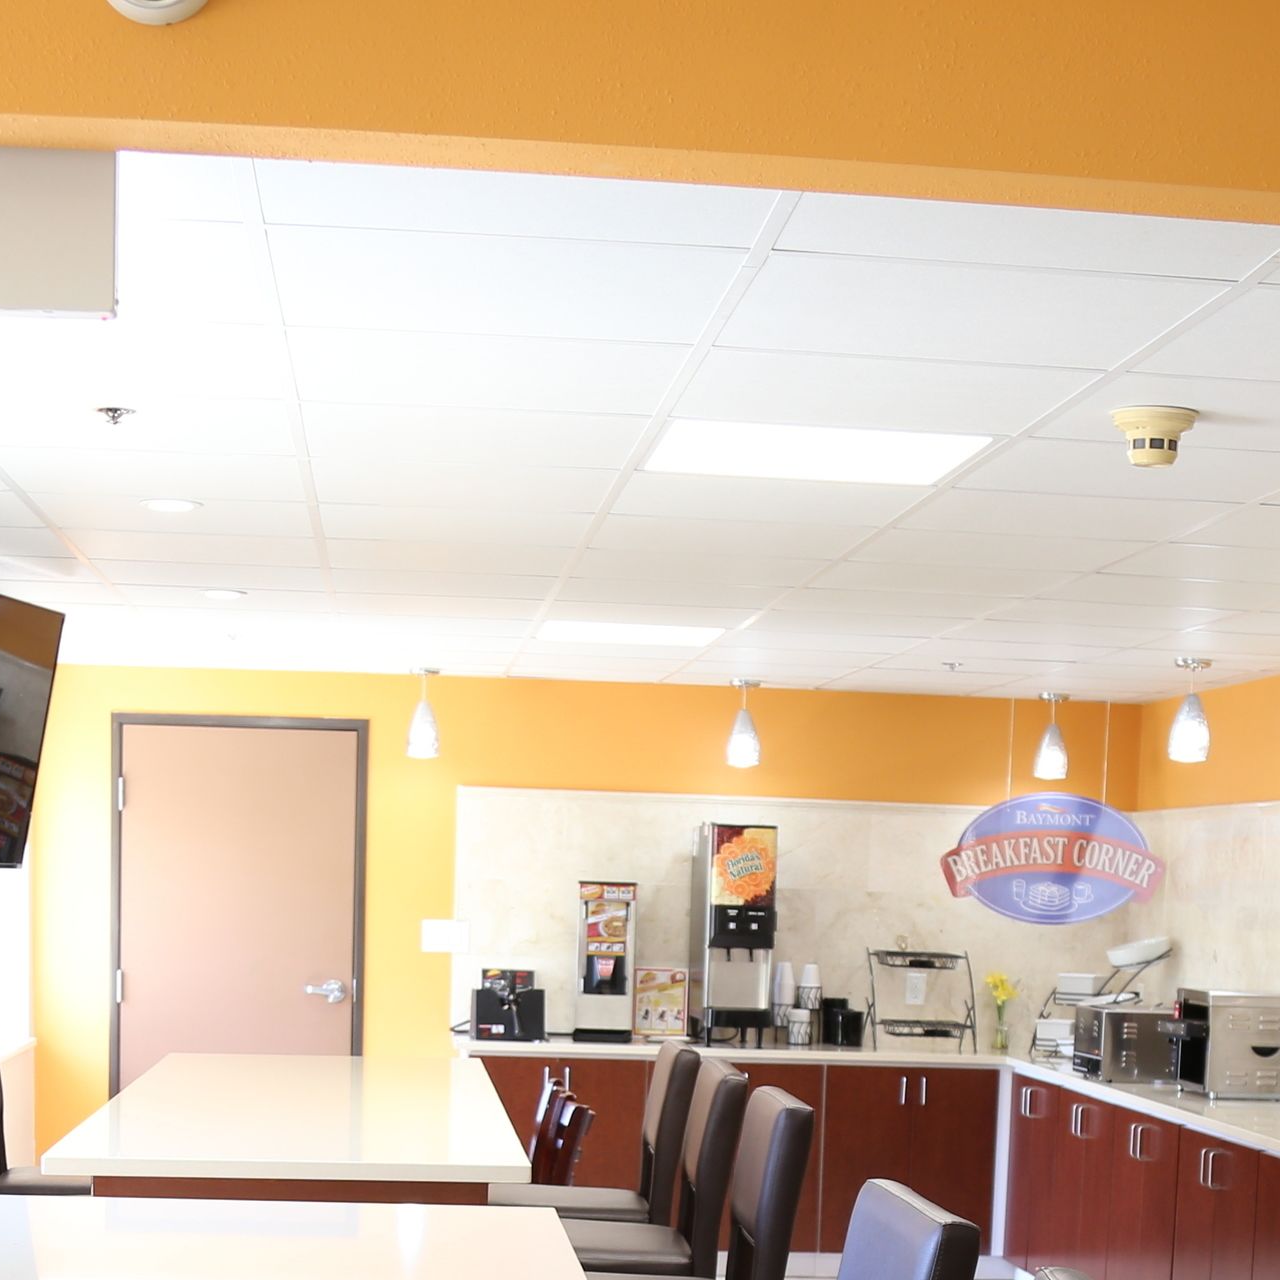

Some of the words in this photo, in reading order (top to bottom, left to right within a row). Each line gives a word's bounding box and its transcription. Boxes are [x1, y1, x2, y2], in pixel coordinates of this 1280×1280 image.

[1016, 810, 1093, 826] BAYMONT
[729, 862, 763, 880] Natural
[947, 836, 1068, 883] BREAKFAST
[1073, 838, 1157, 889] CORNER
